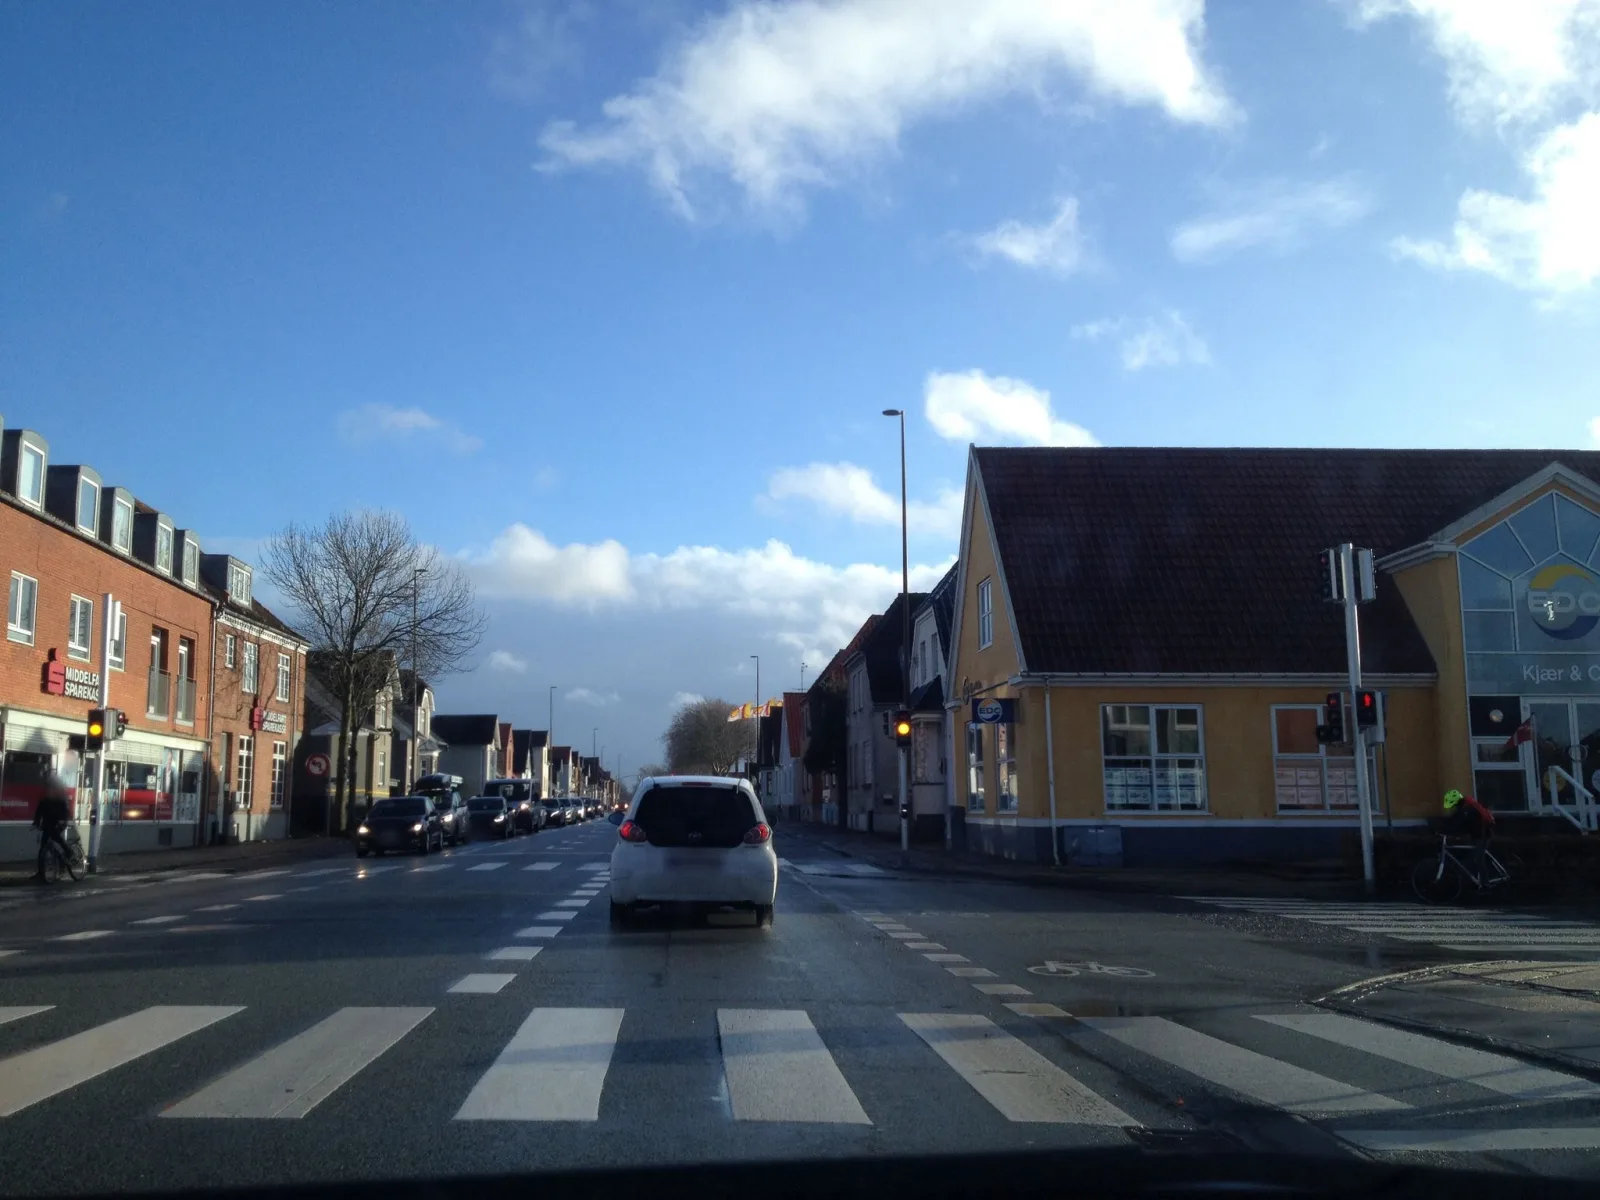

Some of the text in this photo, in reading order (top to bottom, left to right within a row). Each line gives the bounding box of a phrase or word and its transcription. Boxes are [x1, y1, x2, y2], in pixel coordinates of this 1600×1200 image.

[1527, 591, 1600, 613] EDC
[65, 666, 100, 687] MIDDELFA
[1522, 664, 1564, 684] Kjær
[1569, 664, 1582, 681] &
[64, 681, 100, 701] SPAREKAS
[262, 721, 287, 734] SPAREKASSE
